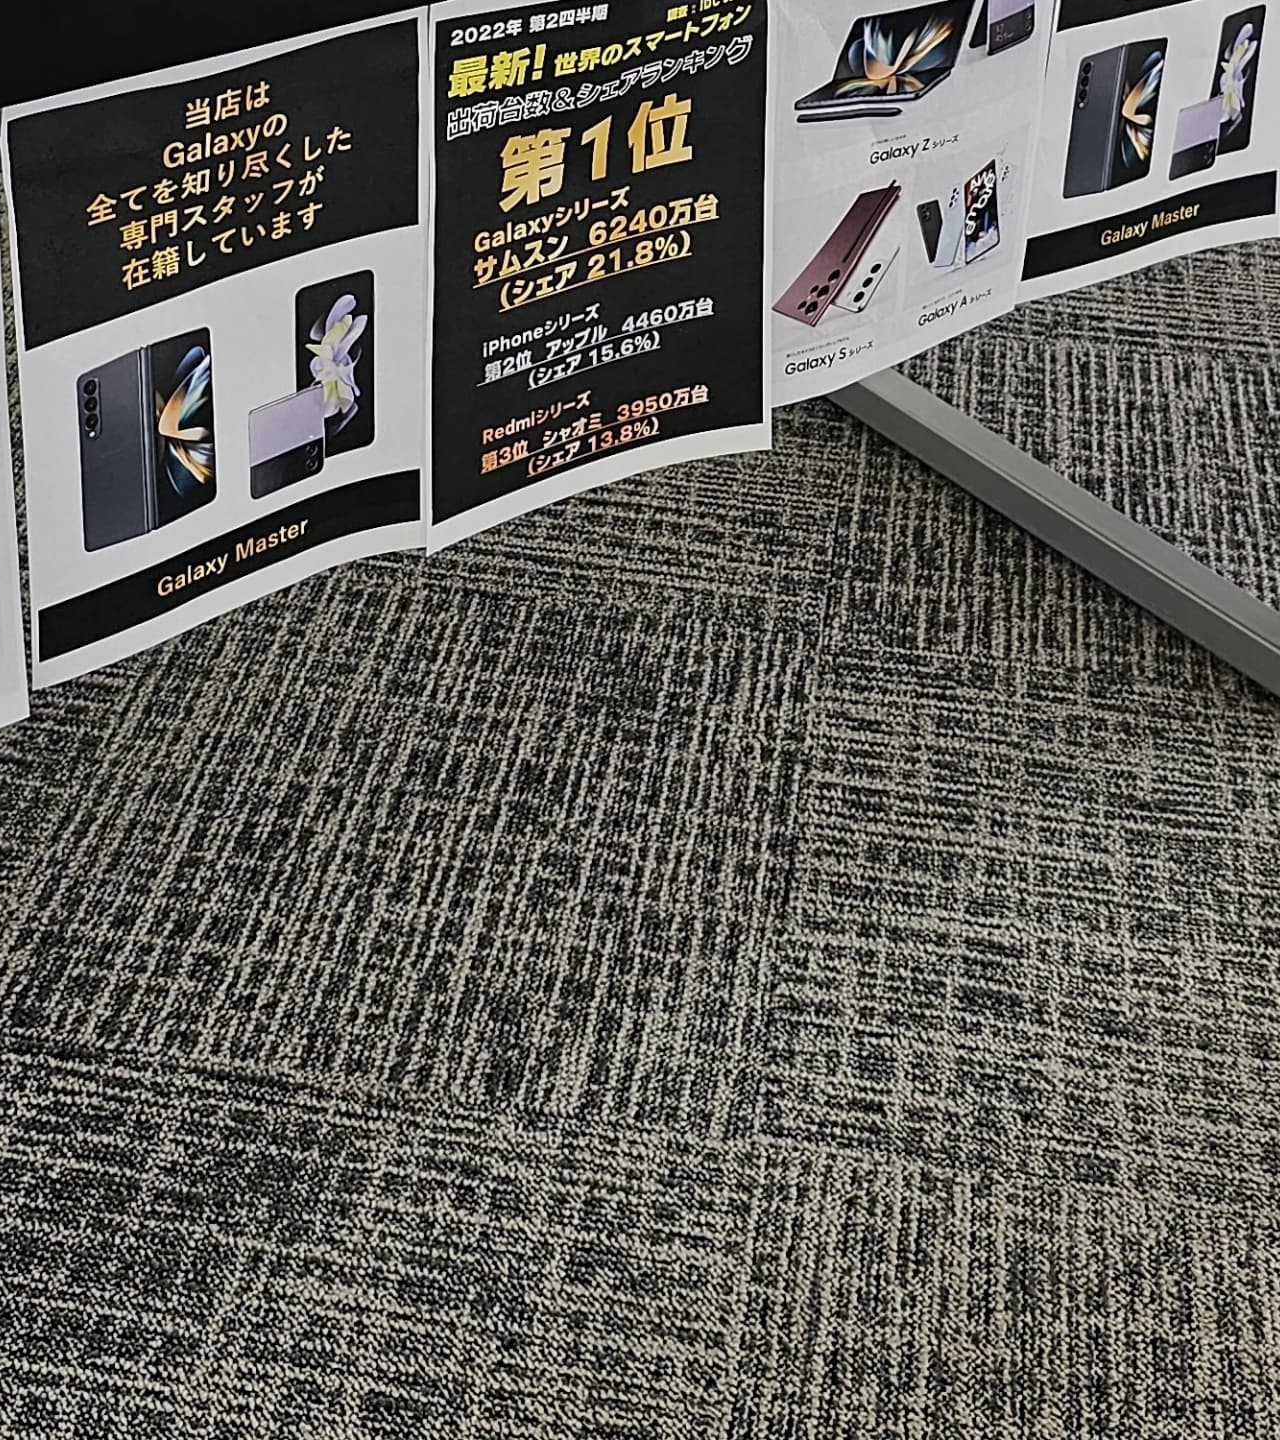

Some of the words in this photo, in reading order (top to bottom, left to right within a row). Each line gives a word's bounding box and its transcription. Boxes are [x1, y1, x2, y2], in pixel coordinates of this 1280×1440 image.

[448, 43, 547, 98] 最新!
[554, 5, 752, 77] 世界のスマートフォン
[450, 19, 523, 46] 2022年
[529, 4, 609, 33] 第2四半期
[185, 81, 271, 130] 当店は
[163, 113, 288, 169] Galaxyの
[498, 93, 693, 213] 第1位
[870, 142, 919, 165] Galaxy
[922, 139, 930, 151] Z
[86, 126, 352, 226] 全てを知り尽くした
[120, 165, 326, 250] 専門スタッフが
[122, 202, 323, 290] 在籍しています
[473, 235, 569, 288] サムスン
[588, 194, 719, 247] 6240万台
[474, 186, 631, 253] Galaxyシリーズ
[1100, 221, 1150, 247] Galaxy
[1151, 203, 1200, 230] Master
[499, 261, 578, 312] (シェア
[587, 231, 692, 280] 21.8%)
[483, 303, 601, 358] iPhoneシリーズ
[484, 352, 532, 384] 第2位
[545, 324, 607, 360] アップル
[622, 297, 714, 333] 4460万台
[918, 302, 959, 327] Galaxy
[960, 296, 968, 307] A
[528, 359, 582, 390] (シェア
[589, 331, 661, 367] 15.6%)
[785, 352, 836, 376] Galaxy
[838, 348, 847, 359] S
[480, 440, 529, 474] 第3位
[543, 412, 602, 449] シャオミ
[617, 385, 709, 422] 3950万台
[527, 444, 580, 477] (シェア
[588, 417, 660, 455] 13.8%)
[157, 553, 229, 599] Galaxy
[234, 517, 309, 563] Master
